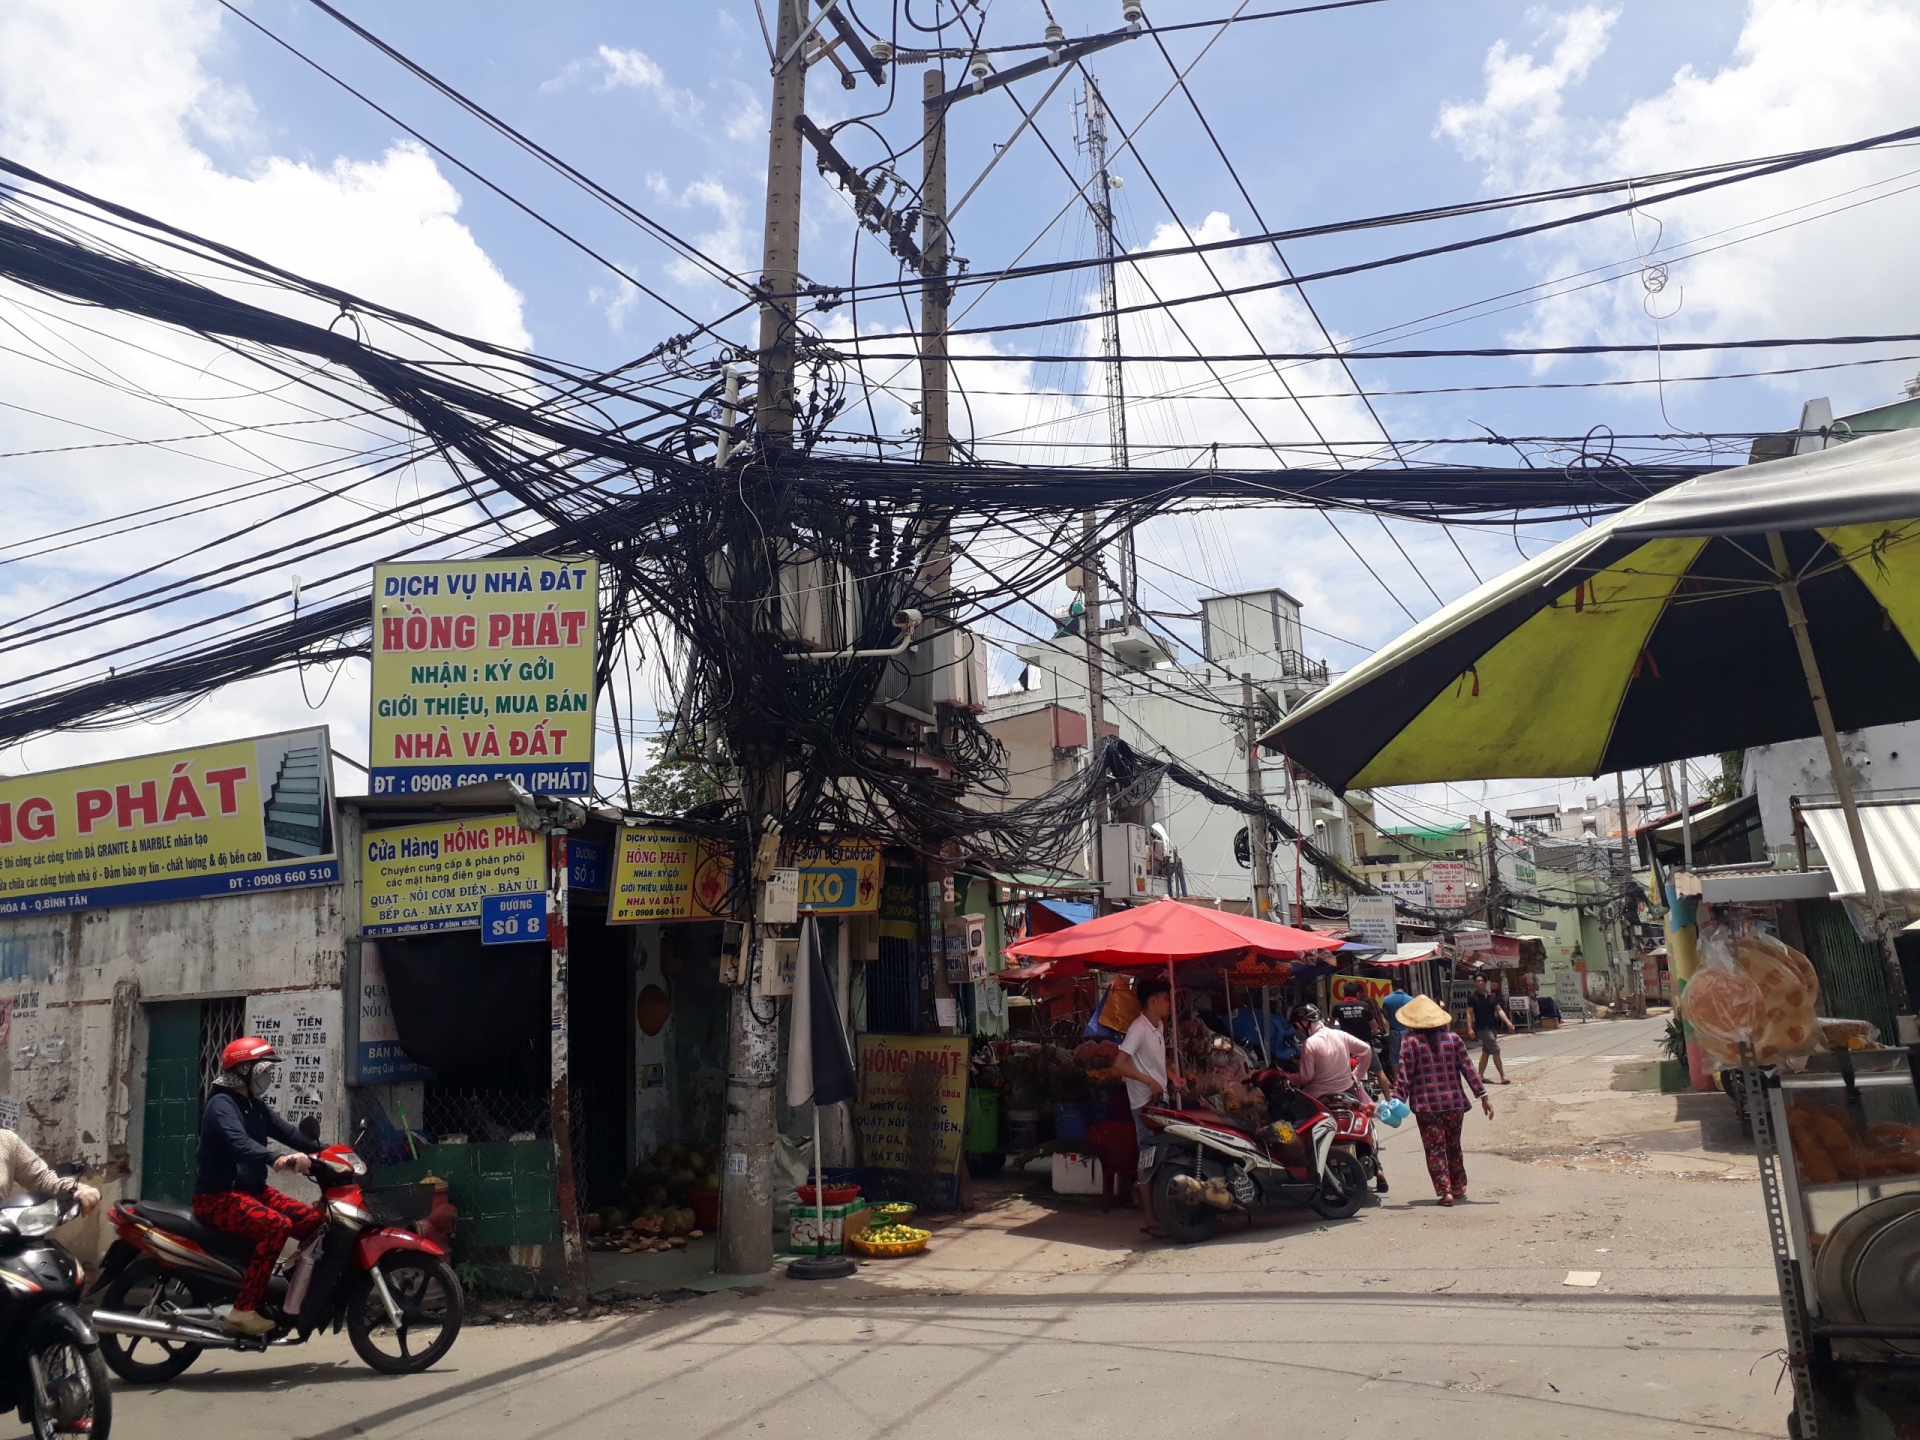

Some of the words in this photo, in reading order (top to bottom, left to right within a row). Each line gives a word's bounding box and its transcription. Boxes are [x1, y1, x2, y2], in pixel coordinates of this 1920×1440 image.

[384, 574, 438, 602] DỊCH
[447, 574, 477, 600] VỤ
[485, 565, 532, 592] NHÀ
[540, 564, 587, 590] ĐẤT
[382, 604, 476, 652] HỒNG
[488, 604, 587, 648] PHÁT
[412, 661, 466, 688] NHẬN
[486, 659, 513, 682] KÝ
[519, 656, 554, 680] GỞI
[378, 694, 417, 717] GIỚI
[424, 693, 489, 720] THIỆU,
[496, 695, 539, 714] MUA
[546, 689, 587, 712] BÁN
[394, 726, 453, 759] NHÀ
[462, 724, 500, 757] VÀ
[509, 719, 568, 756] ĐẤT
[375, 776, 395, 794] ĐT
[411, 774, 452, 792] 0908
[531, 767, 587, 792] (PHÁT)
[76, 762, 247, 834] PHÁT
[368, 835, 396, 862] Cửa
[401, 834, 439, 860] Hàng
[443, 822, 489, 854] HỒNG
[626, 834, 645, 844] DỊCH
[648, 835, 658, 845] VỤ
[660, 834, 676, 843] NHÀ
[678, 834, 692, 843] ĐẤT
[5, 856, 13, 868] thi
[16, 855, 31, 868] công
[34, 853, 45, 865] các
[48, 851, 64, 864] công
[66, 848, 83, 861] trình
[85, 843, 95, 858] ĐÁ
[98, 842, 129, 857] GRANITE
[132, 843, 137, 852] &
[140, 835, 172, 851] MARBLE
[174, 834, 192, 847] nhân
[195, 834, 208, 847] tạo
[576, 846, 597, 861] ĐƯỜNG
[626, 844, 657, 863] HỒNG
[660, 849, 687, 863] PHÁT
[9, 877, 24, 889] chữa
[27, 876, 38, 887] các
[40, 874, 56, 887] công
[59, 871, 75, 884] trình
[78, 869, 90, 882] nhà
[104, 864, 121, 879] Đảm
[123, 863, 136, 877] bảo
[139, 865, 147, 876] uy
[149, 861, 159, 874] tín
[166, 856, 183, 872] chất
[186, 857, 207, 871] lượng
[210, 855, 215, 866] &
[218, 853, 227, 869] độ
[230, 849, 245, 864] bền
[248, 851, 261, 862] cao
[381, 864, 416, 876] Chuyên
[419, 861, 442, 874] cung
[444, 857, 462, 870] cấp
[475, 855, 500, 868] phân
[503, 851, 525, 864] phối
[386, 876, 403, 887] các
[405, 874, 422, 888] mặt
[426, 871, 449, 887] hàng
[452, 871, 473, 881] điện
[476, 870, 491, 879] gia
[494, 867, 519, 876] dụng
[574, 863, 587, 882] SỐ
[590, 869, 595, 883] 3
[634, 868, 652, 880] NHẬN
[658, 868, 667, 878] KÝ
[21, 901, 27, 911] A
[35, 897, 66, 911] Q.BÌNH
[68, 894, 88, 906] TÂN
[229, 876, 243, 890] ĐT
[254, 872, 282, 887] 0908
[285, 870, 306, 884] 660
[310, 867, 331, 880] 510
[370, 893, 399, 908] QUẠT
[409, 886, 428, 901] NỒI
[432, 887, 455, 899] CƠM
[460, 884, 487, 897] ĐIỆN
[498, 880, 521, 892] BÀN
[526, 877, 538, 890] ỦI
[621, 882, 635, 892] GIỚI
[637, 882, 658, 894] THIỆU,
[675, 882, 688, 891] BÁN
[500, 898, 532, 911] ĐƯỜNG
[627, 896, 645, 906] NHÀ
[649, 895, 660, 905] VÀ
[664, 894, 680, 904] ĐẤT
[379, 902, 400, 920] BẾP
[403, 908, 418, 918] GA
[428, 902, 452, 915] MÁY
[456, 902, 479, 912] XAY
[398, 924, 418, 933] ĐƯỜNG
[420, 922, 428, 931] SỐ
[492, 914, 519, 935] SỐ
[527, 917, 540, 933] 8
[362, 1000, 381, 1018] NỒI
[256, 1018, 280, 1029] TIỀN
[297, 1015, 322, 1027] TIỀN
[270, 1036, 276, 1046] 55
[278, 1035, 284, 1046] 69
[291, 1032, 303, 1045] 0937
[305, 1033, 310, 1044] 21
[312, 1032, 318, 1044] 55
[320, 1032, 326, 1044] 69
[369, 1044, 390, 1058] BÁN
[864, 1039, 909, 1074] HỒNG
[290, 1072, 301, 1083] 0937
[310, 1072, 316, 1083] 55
[318, 1072, 324, 1083] 69
[362, 1064, 382, 1076] Hương
[383, 1062, 394, 1074] Quế
[942, 1087, 961, 1099] chữa
[287, 1111, 298, 1122] 0937
[865, 1130, 884, 1144] BẾP
